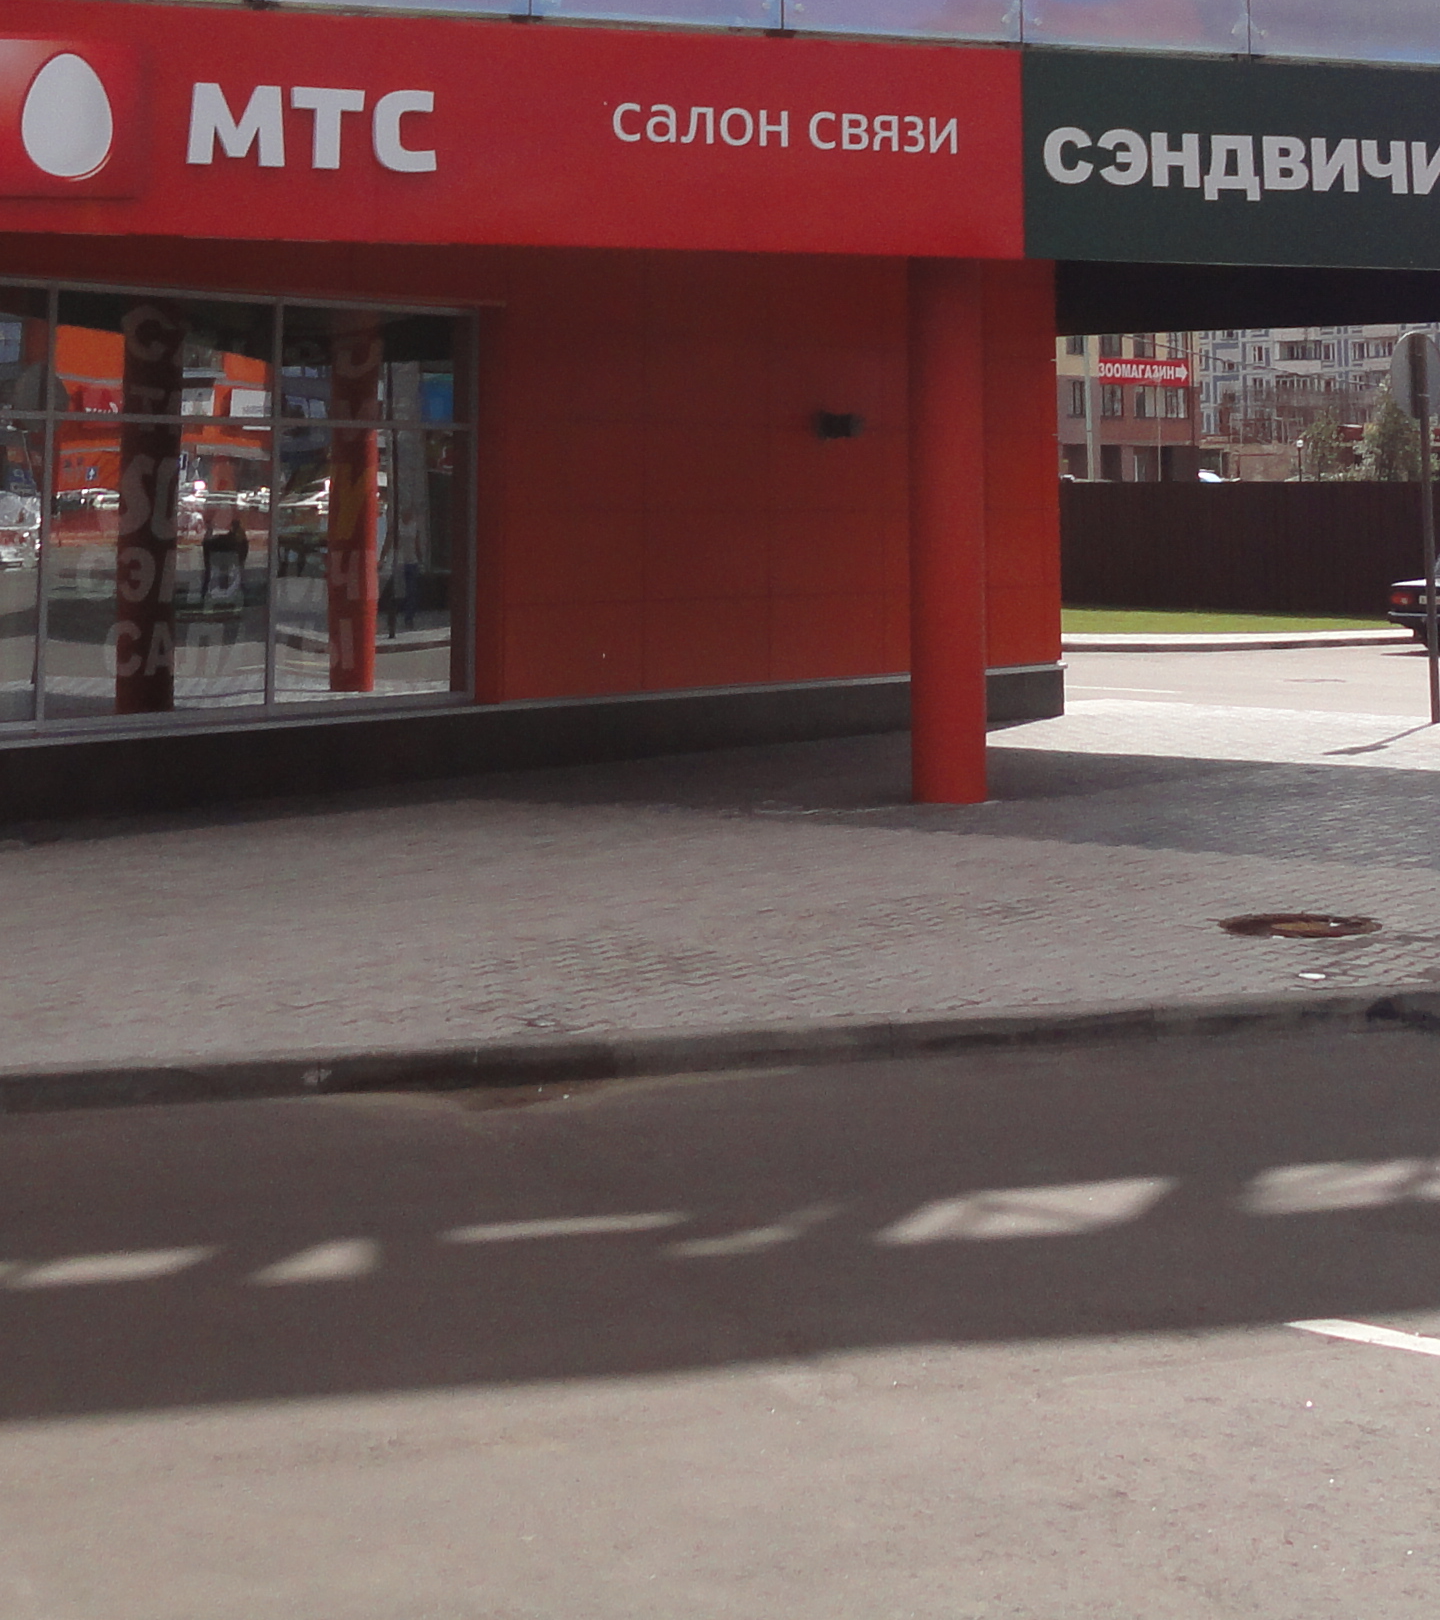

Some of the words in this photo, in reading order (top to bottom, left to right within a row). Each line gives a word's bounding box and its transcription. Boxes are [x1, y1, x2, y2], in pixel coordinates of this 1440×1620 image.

[187, 82, 438, 173] МТС
[611, 98, 791, 149] салон
[808, 107, 960, 156] связи
[1098, 362, 1175, 380] ЗООМАГАЗИН
